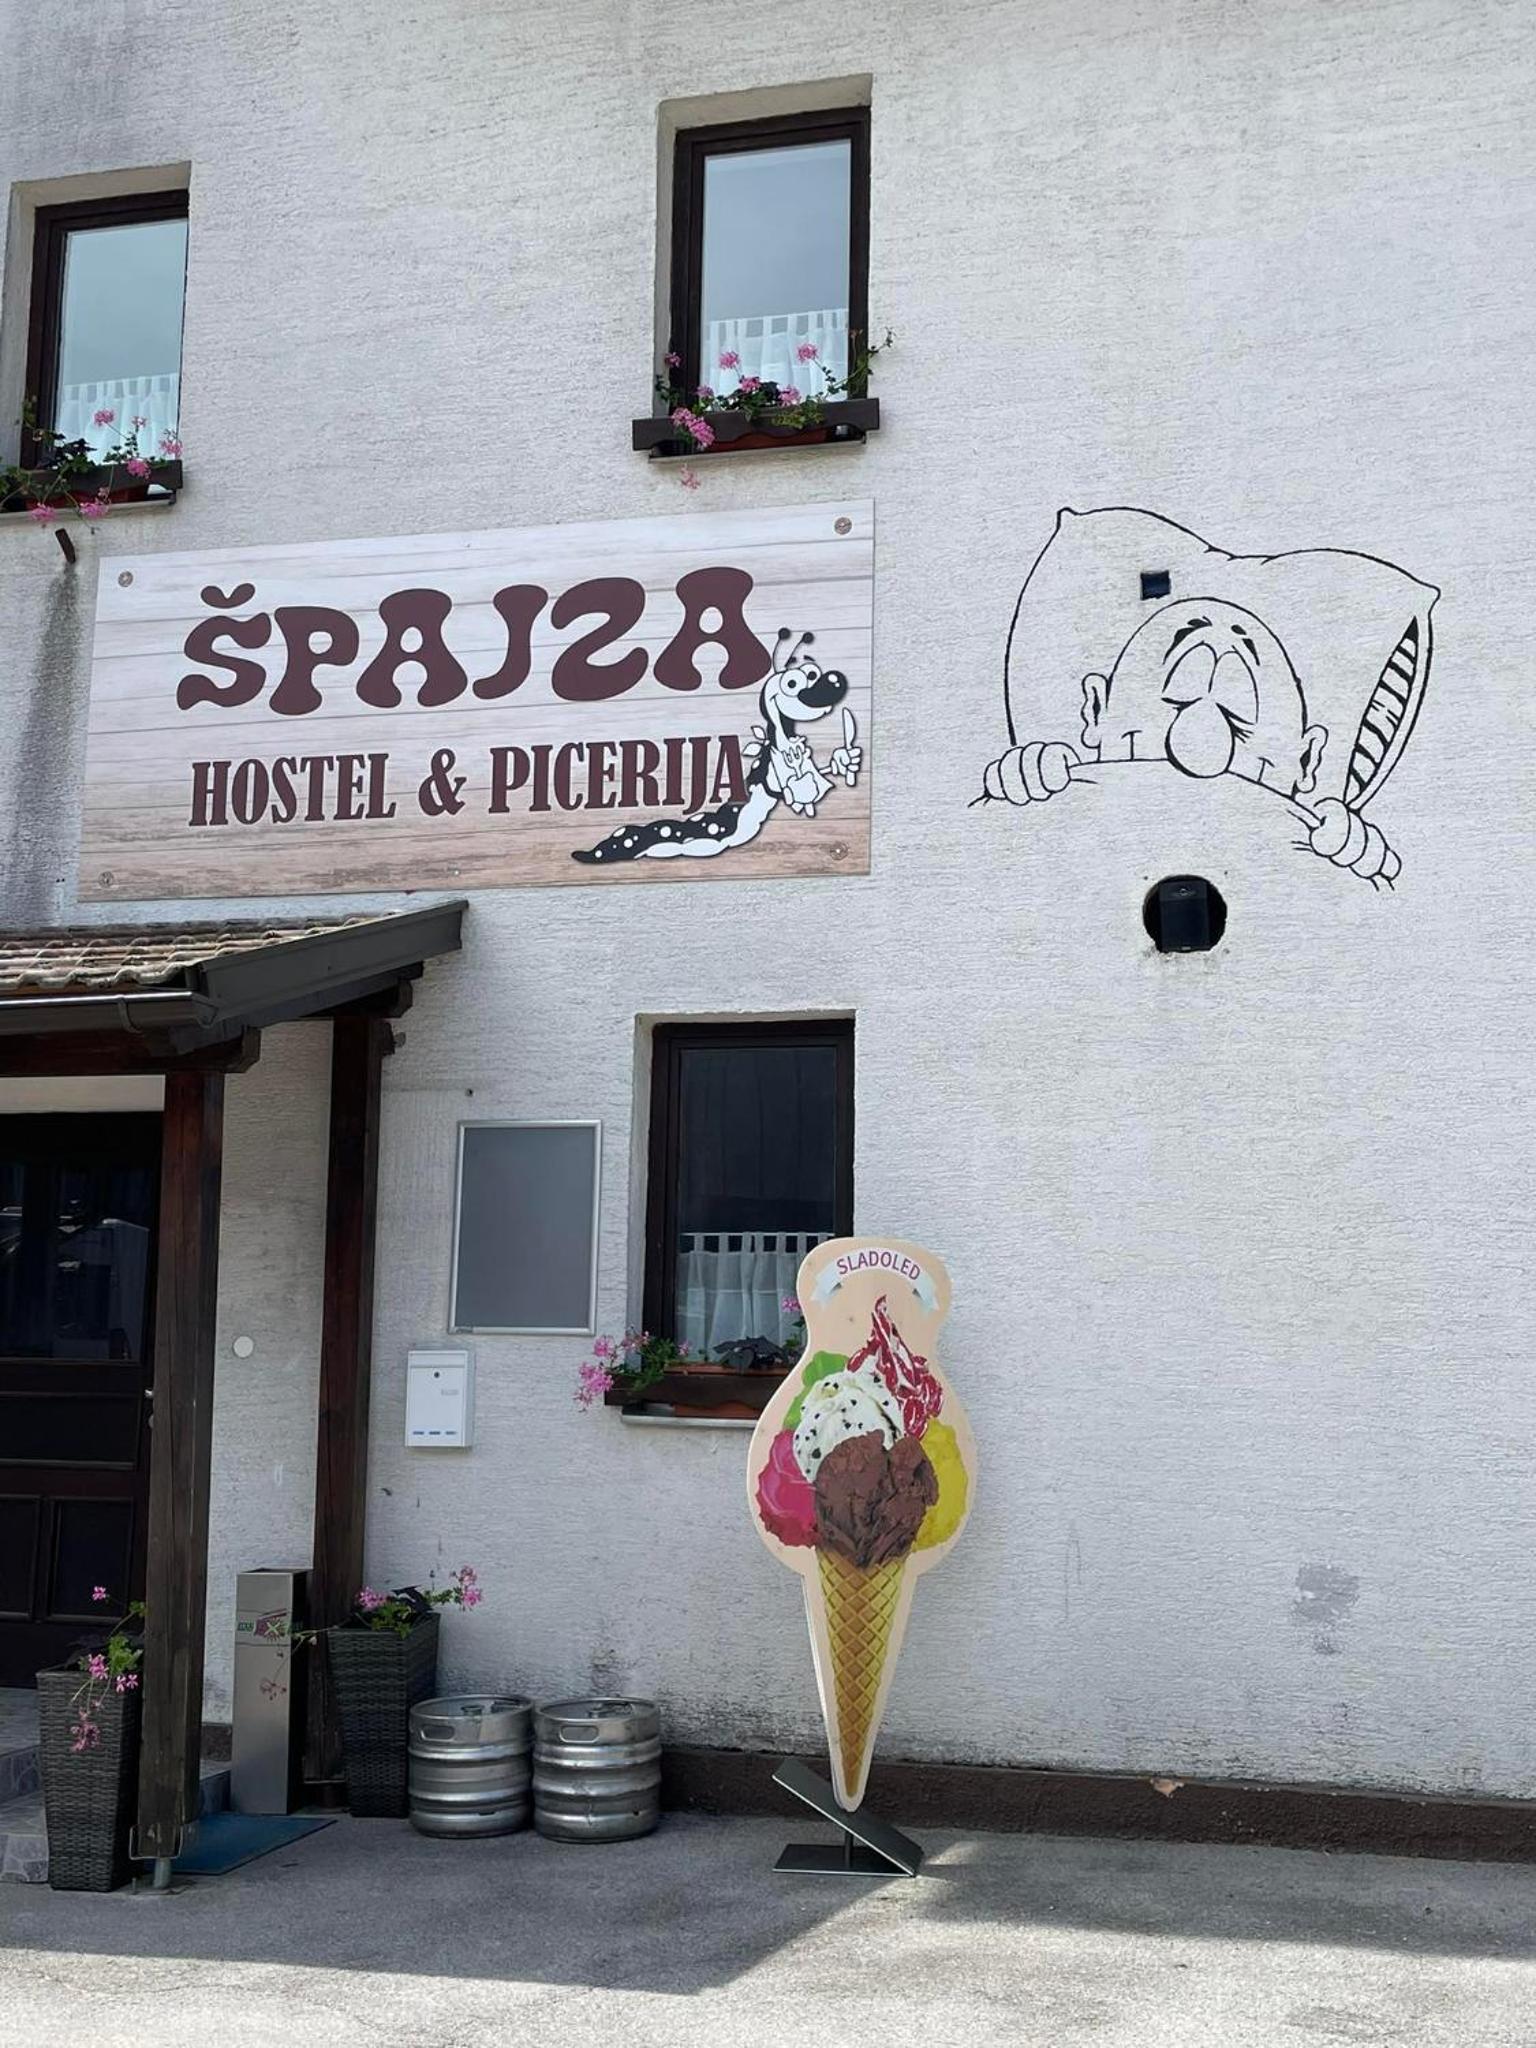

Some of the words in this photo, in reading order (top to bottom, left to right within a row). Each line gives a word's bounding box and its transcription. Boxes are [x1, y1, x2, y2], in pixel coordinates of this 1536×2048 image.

[176, 566, 773, 716] ŠPAJZA
[188, 753, 397, 827] HOSTEL
[418, 748, 467, 817] &
[488, 734, 751, 816] PICERIJA
[836, 1251, 920, 1280] SLADOLED
